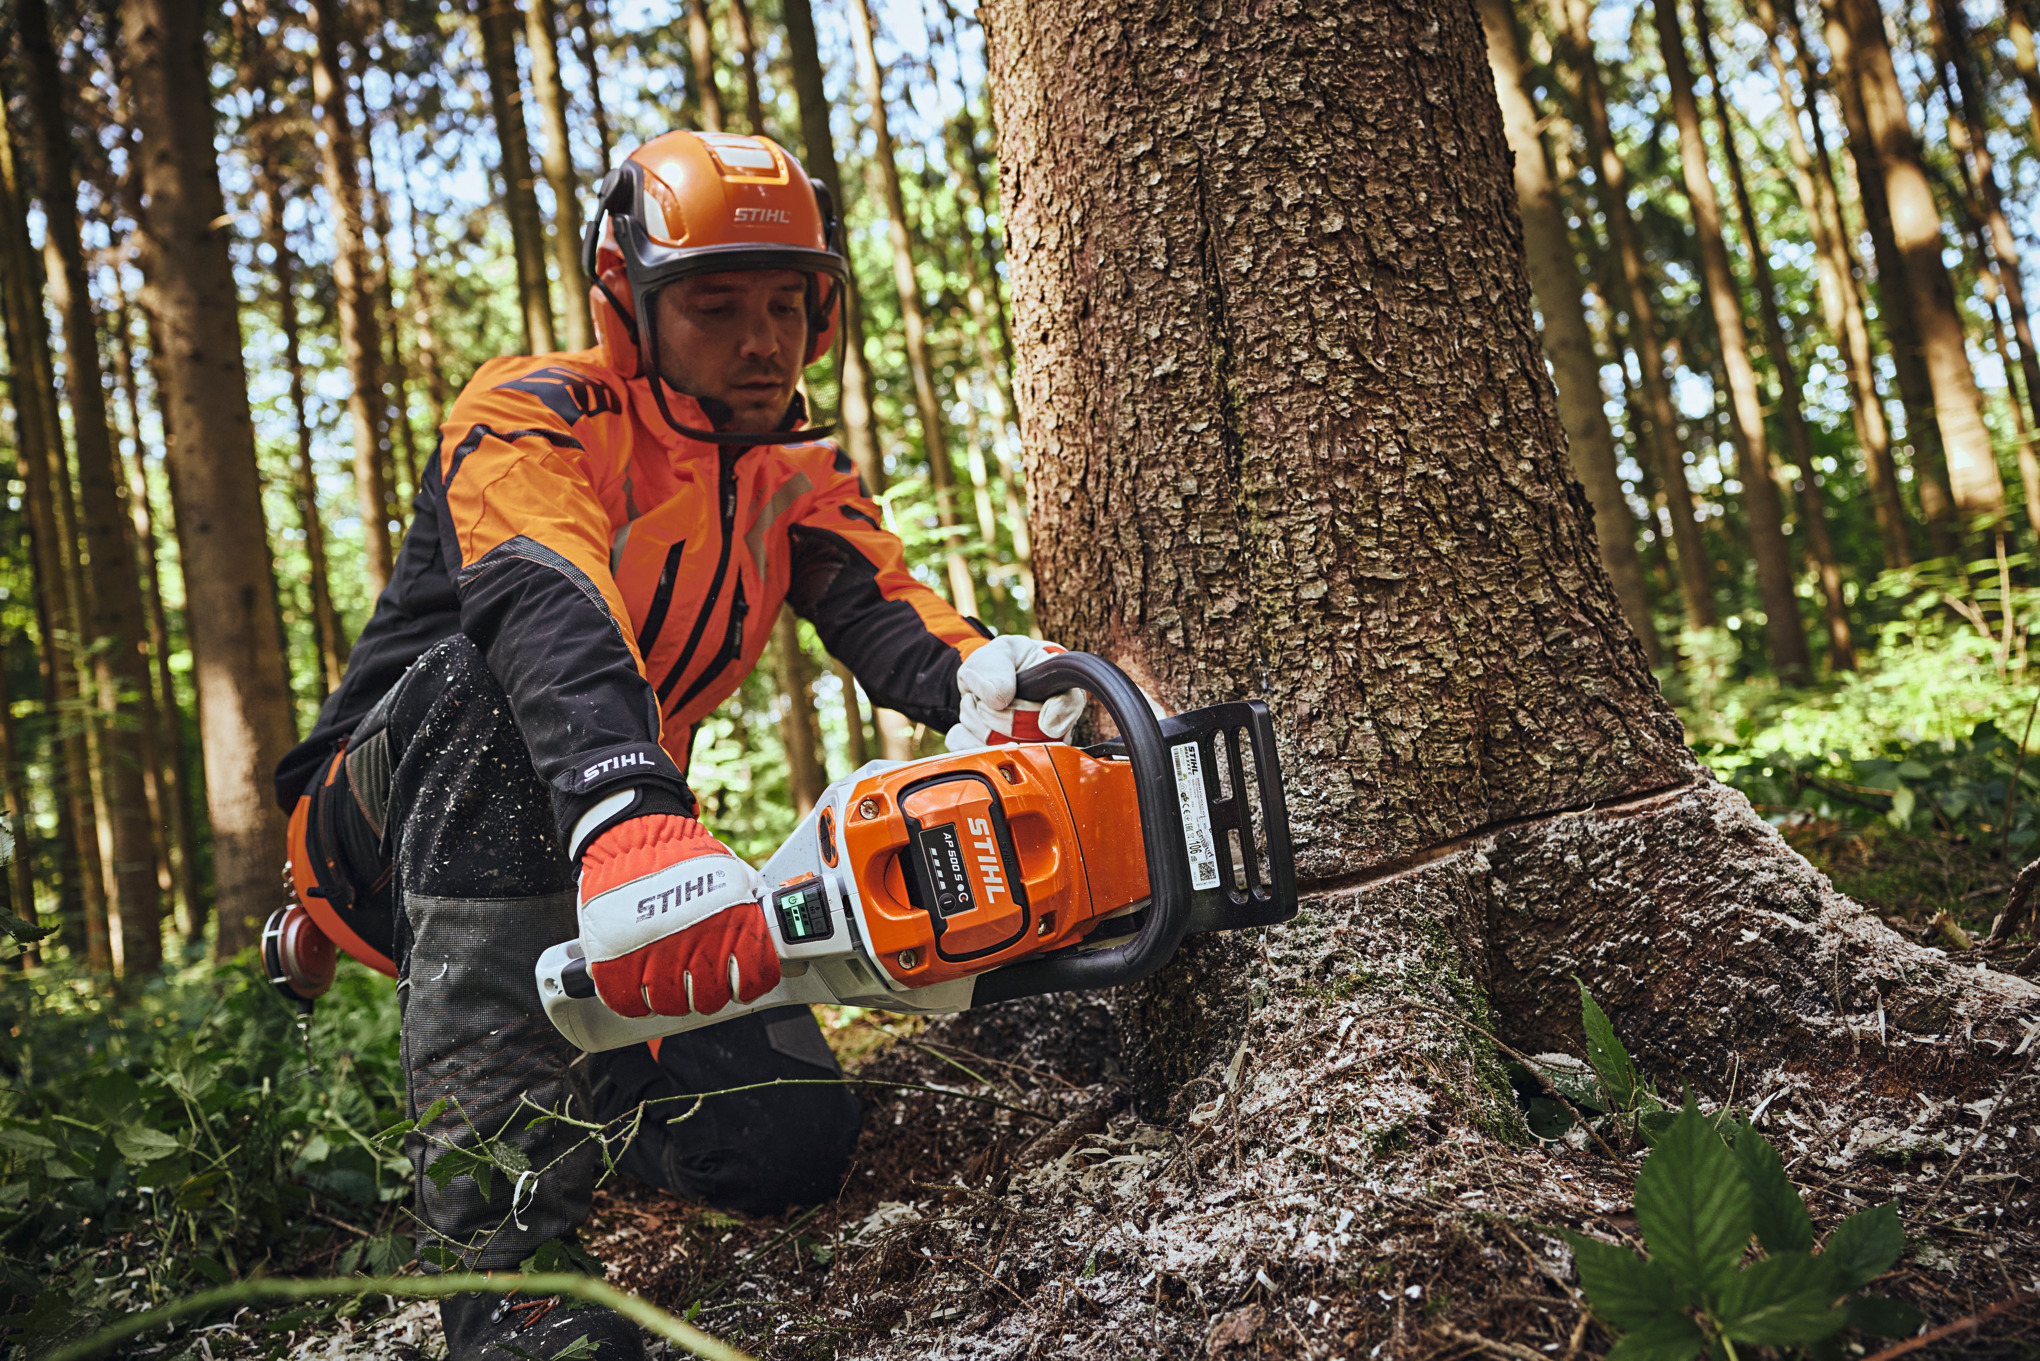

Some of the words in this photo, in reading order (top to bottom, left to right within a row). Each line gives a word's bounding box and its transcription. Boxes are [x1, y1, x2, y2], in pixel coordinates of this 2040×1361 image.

[734, 208, 790, 224] STIHL
[583, 752, 656, 782] STIHL
[1188, 745, 1199, 776] STIHL
[942, 832, 955, 848] AP
[1189, 840, 1203, 855] 106
[947, 849, 961, 872] 500
[967, 818, 1006, 904] STIHL
[953, 873, 964, 882] S
[636, 873, 727, 923] STIHL
